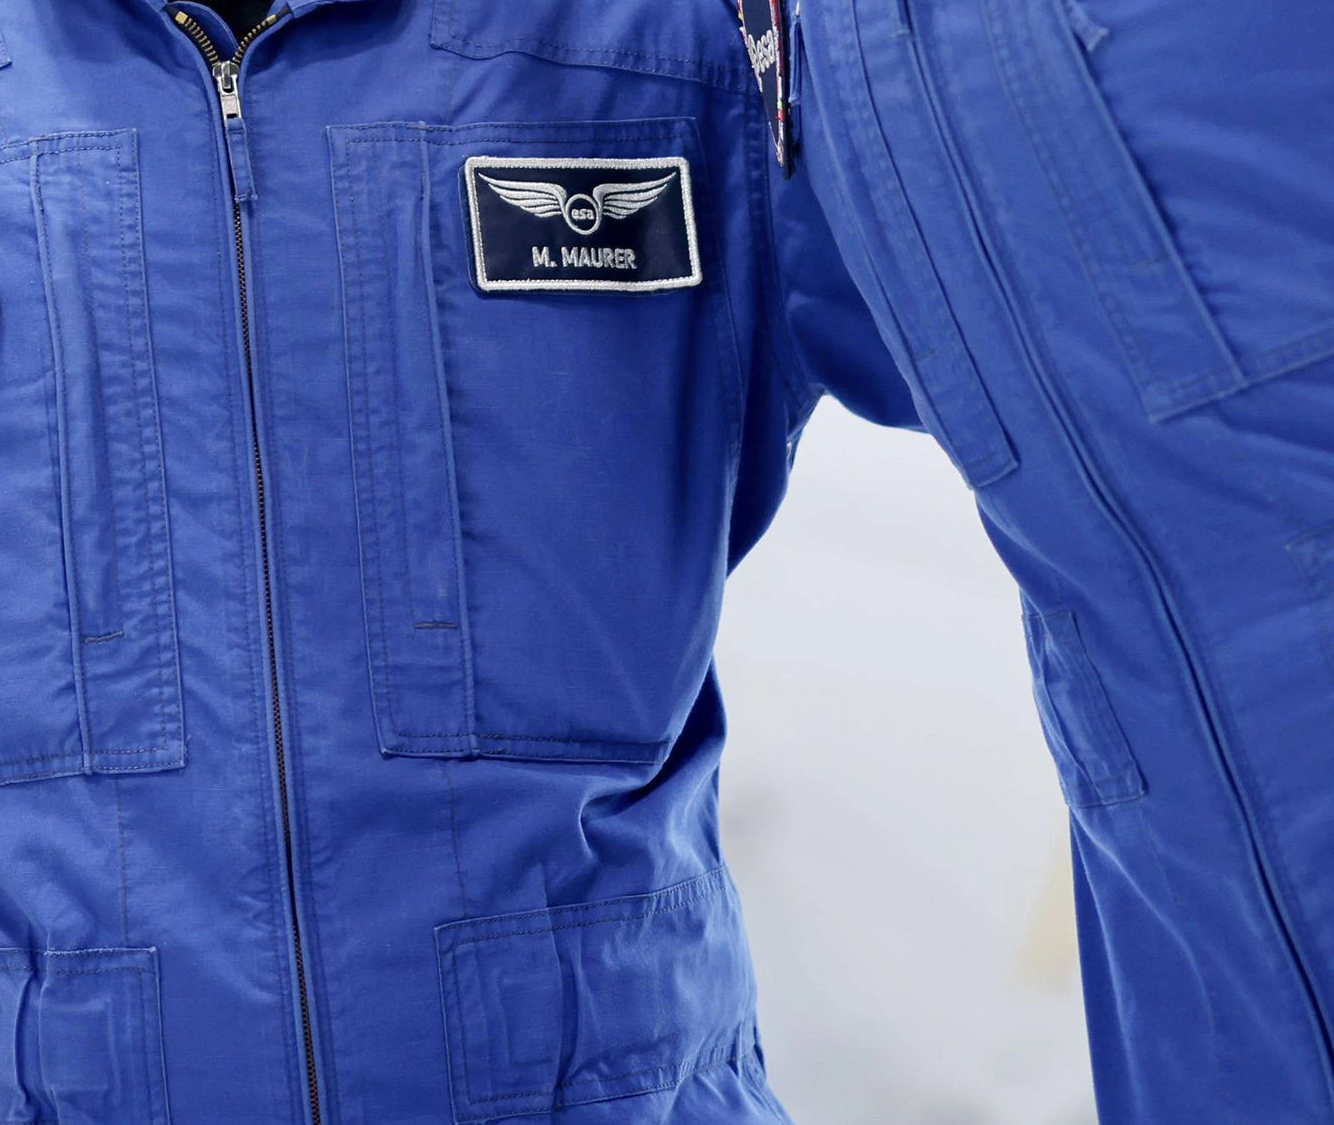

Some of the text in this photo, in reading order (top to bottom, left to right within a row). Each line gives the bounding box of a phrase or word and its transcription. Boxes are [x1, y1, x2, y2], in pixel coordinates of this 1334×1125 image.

[571, 208, 595, 220] esa
[531, 246, 637, 269] M. MAURER
